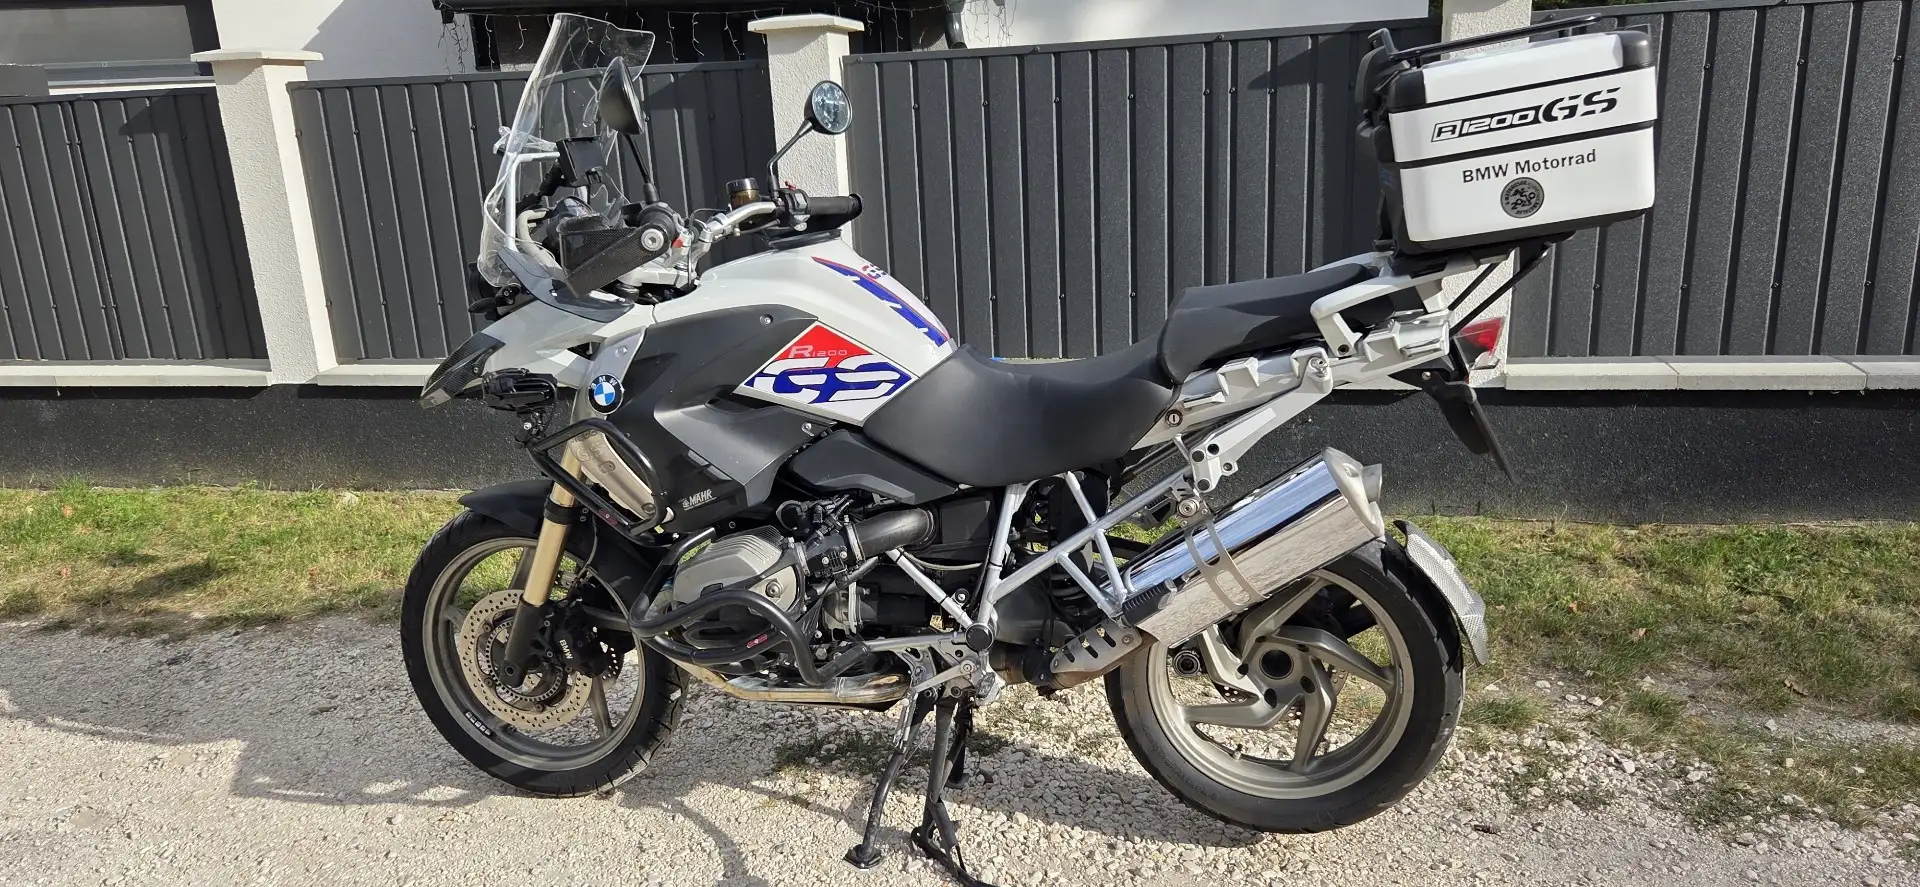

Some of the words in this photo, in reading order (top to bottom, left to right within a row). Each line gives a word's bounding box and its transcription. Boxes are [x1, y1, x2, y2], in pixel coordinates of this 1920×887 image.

[1462, 163, 1509, 183] BMW
[1515, 149, 1597, 175] Motorrad
[788, 345, 848, 359] R1200
[590, 375, 618, 390] BMW
[559, 639, 574, 659] BMW
